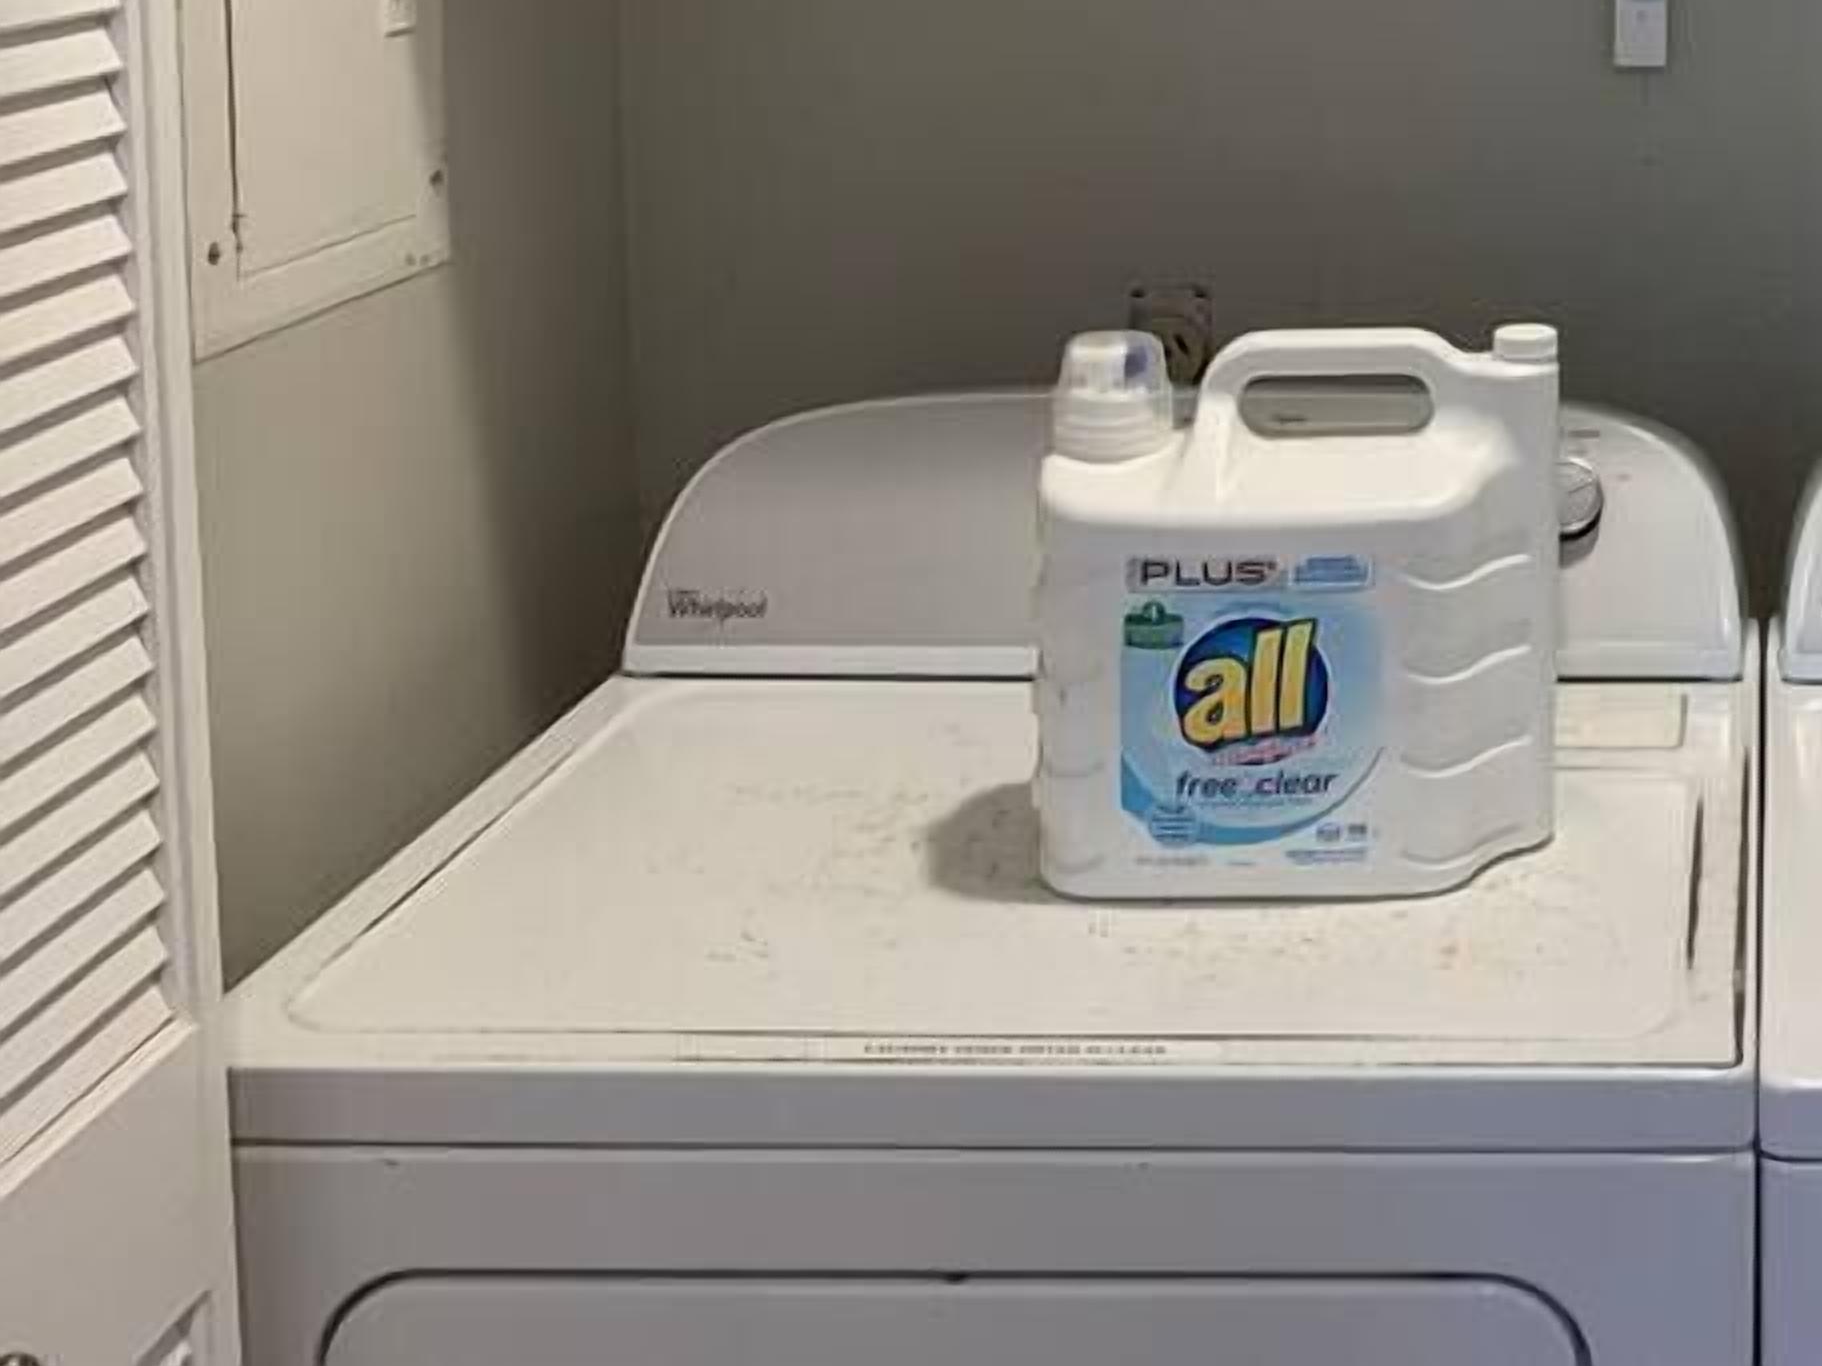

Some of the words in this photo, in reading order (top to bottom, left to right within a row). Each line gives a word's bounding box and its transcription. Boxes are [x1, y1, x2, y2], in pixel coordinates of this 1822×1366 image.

[1183, 619, 1315, 746] all
[1175, 769, 1237, 799] free
[1255, 769, 1340, 795] clear
